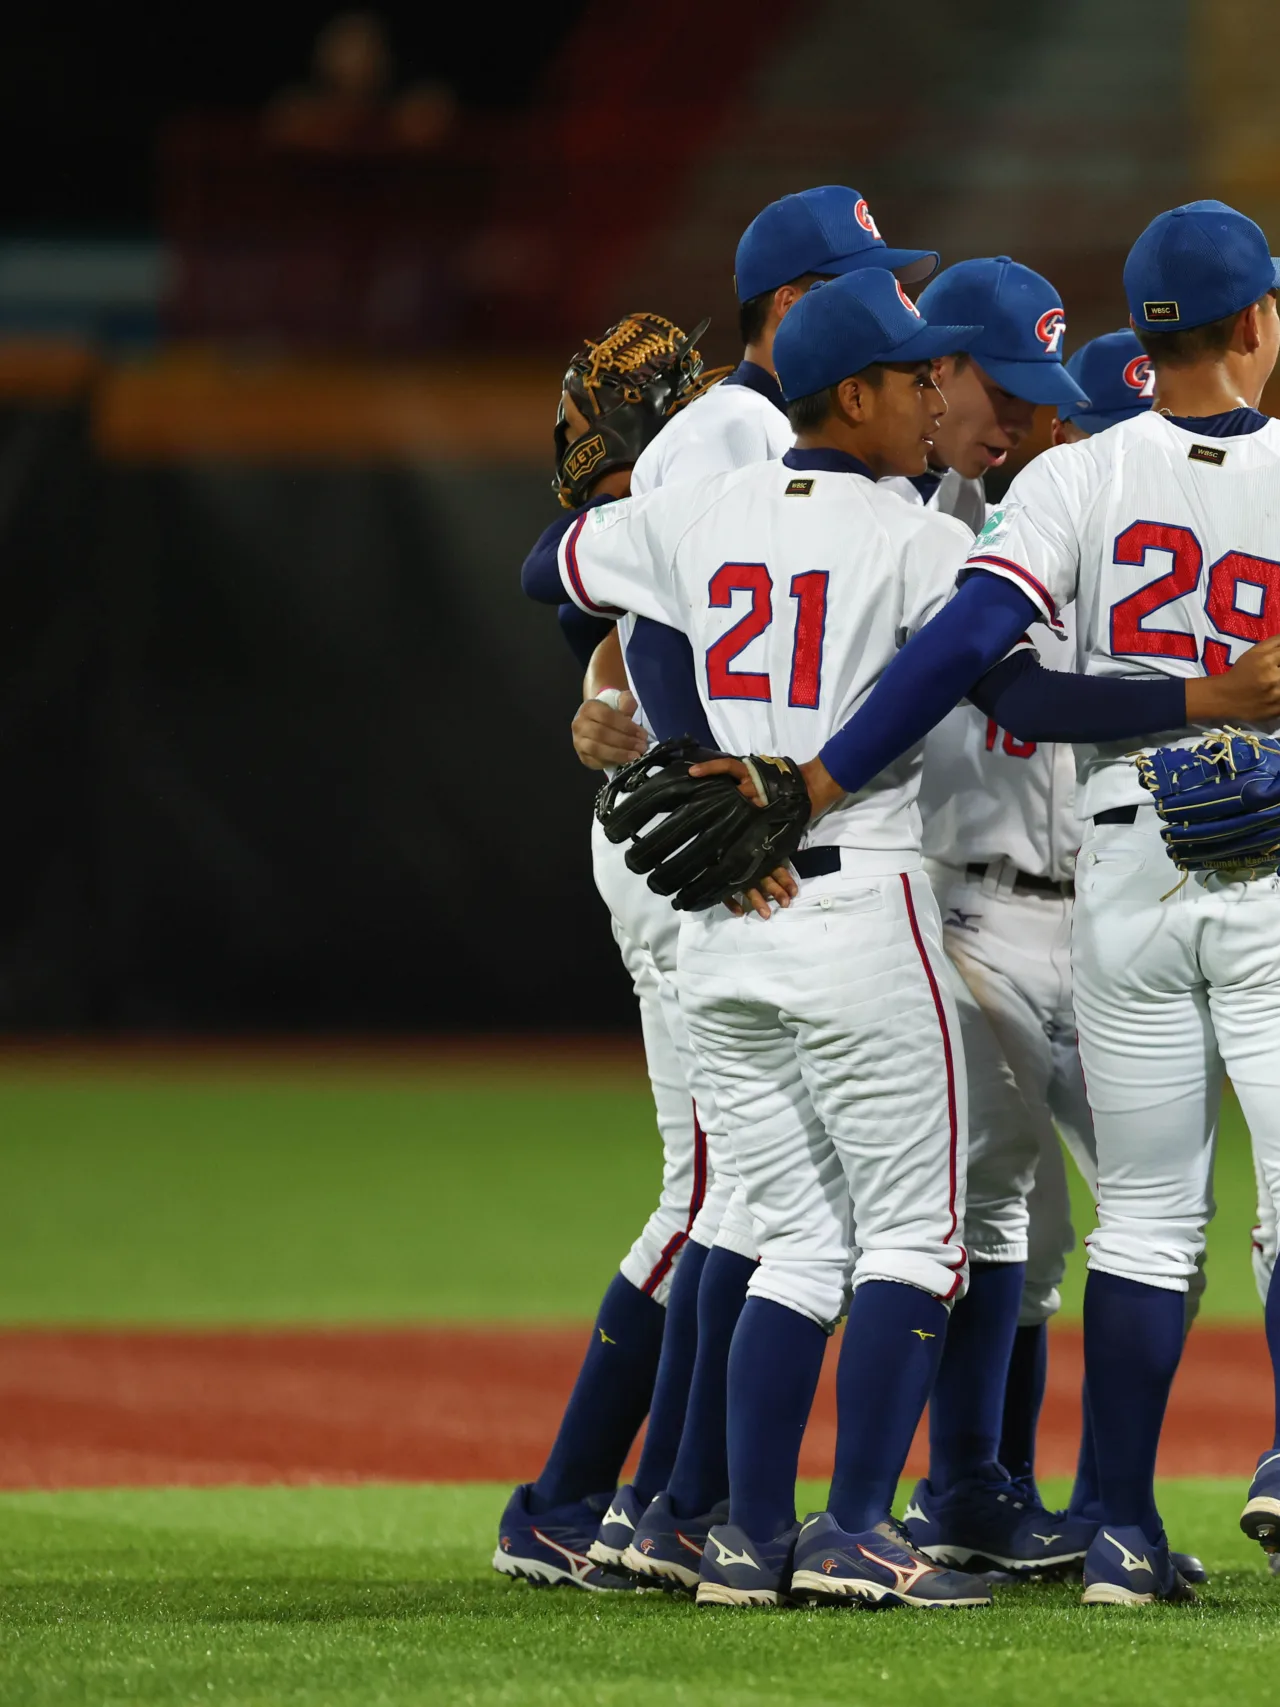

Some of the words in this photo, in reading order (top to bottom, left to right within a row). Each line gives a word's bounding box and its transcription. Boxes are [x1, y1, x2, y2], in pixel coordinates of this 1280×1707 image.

[568, 439, 600, 473] ZETT
[1197, 448, 1219, 458] WBSC
[706, 562, 829, 710] 21
[1202, 857, 1240, 869] Uzumaki
